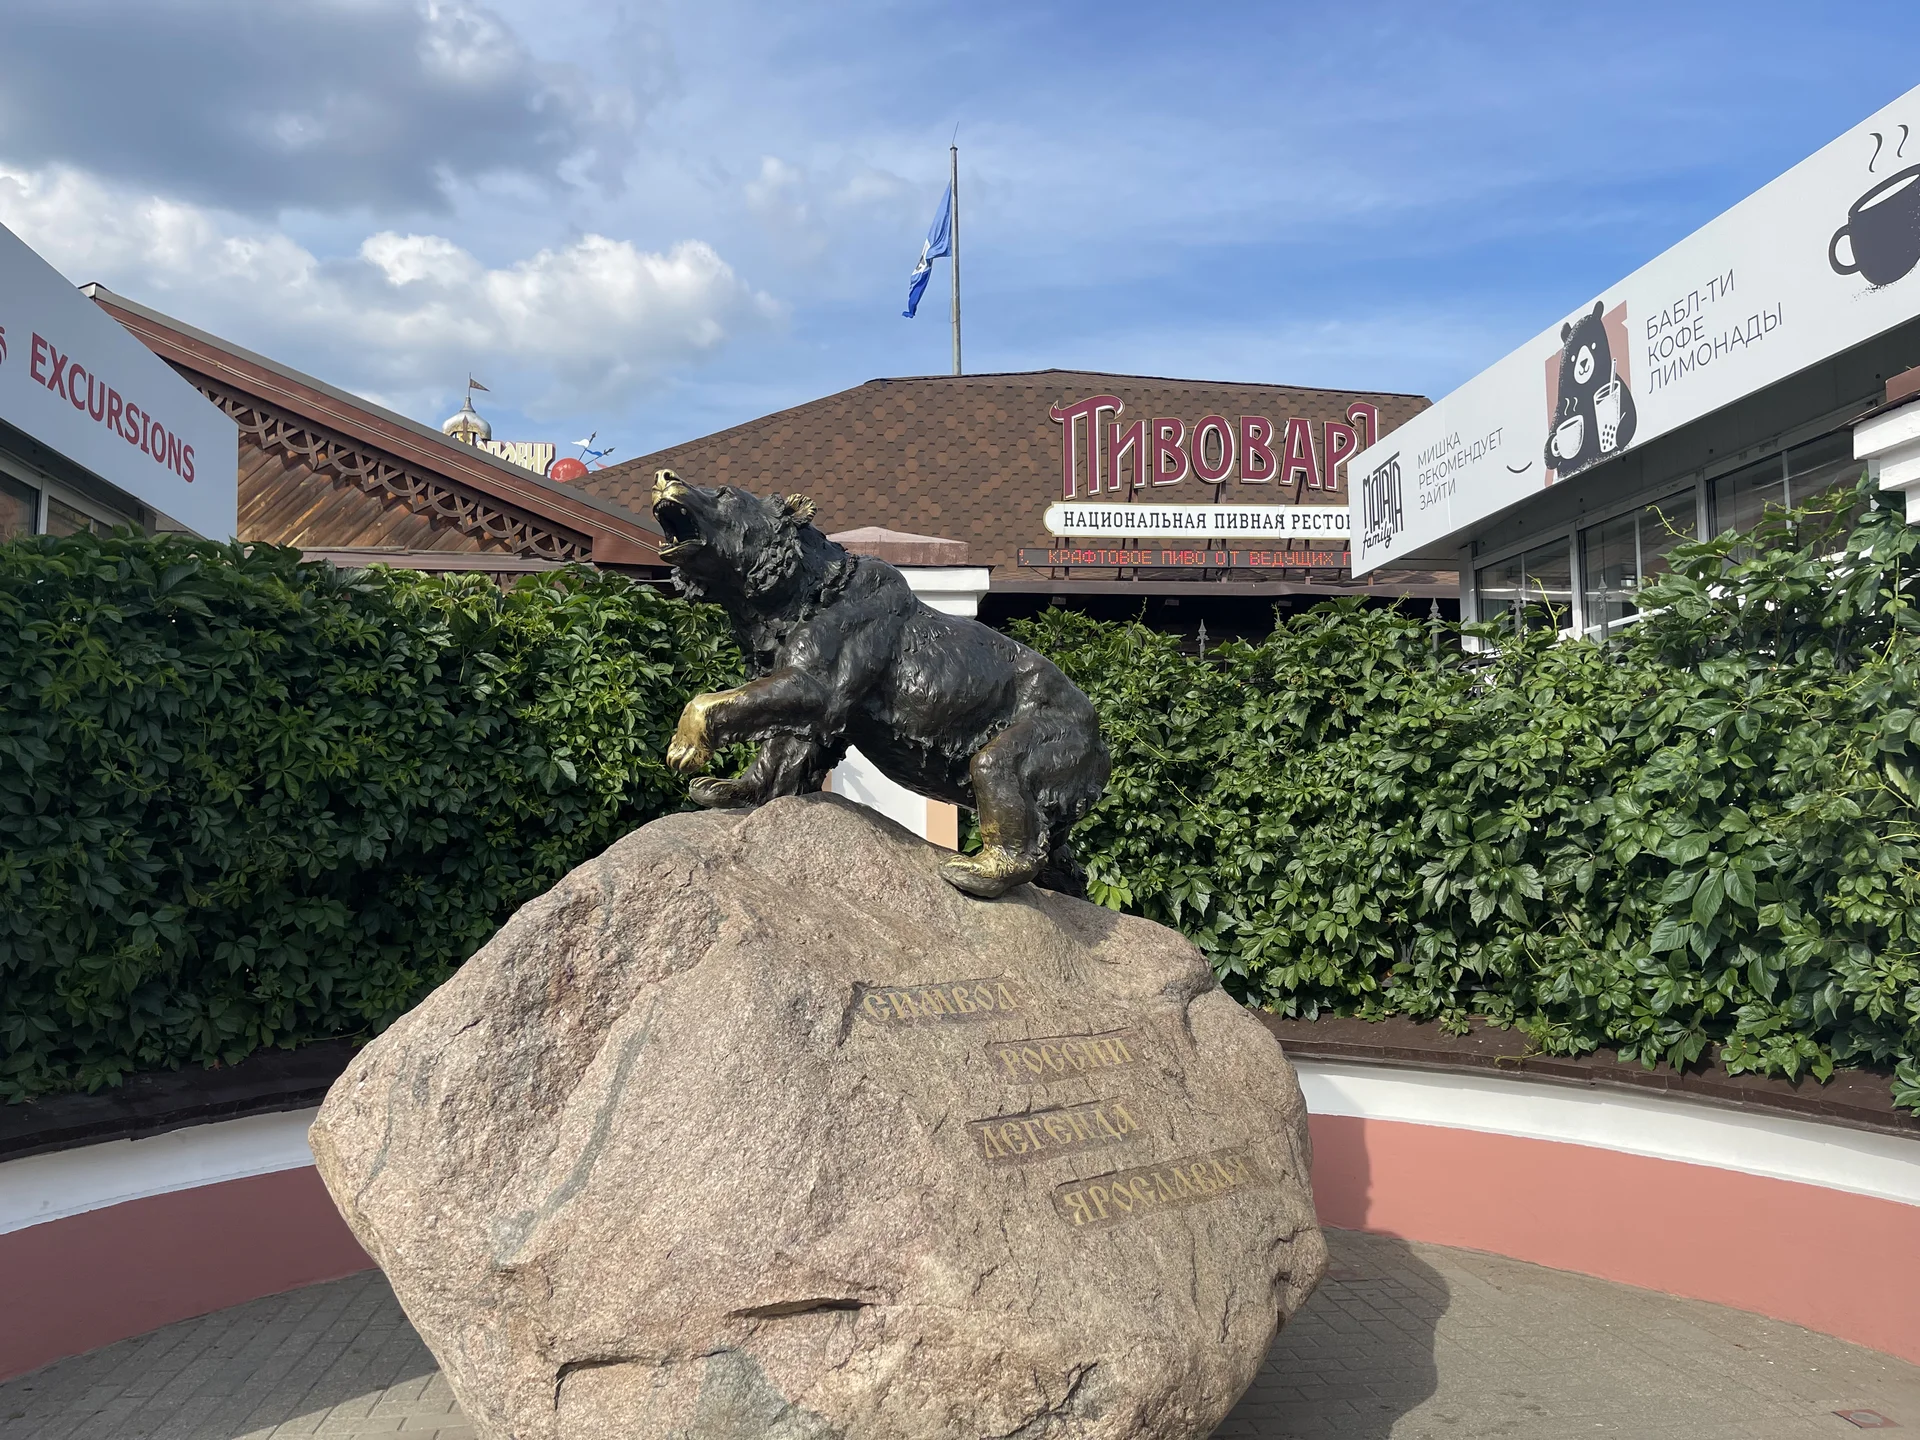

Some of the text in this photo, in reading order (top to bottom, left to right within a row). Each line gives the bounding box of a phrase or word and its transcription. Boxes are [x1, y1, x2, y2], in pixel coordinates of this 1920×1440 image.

[1646, 268, 1735, 341] БАБЛ-ТИ
[1648, 315, 1706, 367] КОФЕ
[1648, 302, 1783, 395] ЛИМОНАДЫ
[30, 331, 196, 484] EXCURSIONS
[1417, 431, 1462, 470] МИШКА
[1418, 427, 1504, 490] РЕКОМЕНДУЕТ
[1419, 477, 1457, 511] ЗАЙТИ
[1063, 511, 1207, 530] НАЦИОНАЛЬНАЯ
[1214, 512, 1285, 530] ПИВНАЯ
[1361, 520, 1394, 561] family
[1048, 549, 1152, 566] КРАФТОВОЕ
[1161, 550, 1206, 566] ПИВО
[1215, 550, 1241, 566] ОТ
[1249, 550, 1334, 568] ВЕДУЩИХ
[862, 982, 1020, 1022] СИМВОЛ
[999, 1037, 1135, 1079] РОССИИ
[981, 1102, 1140, 1160] ЛЕГЕНДА
[1063, 1152, 1255, 1227] ЯРОСЛАВЛЯ
